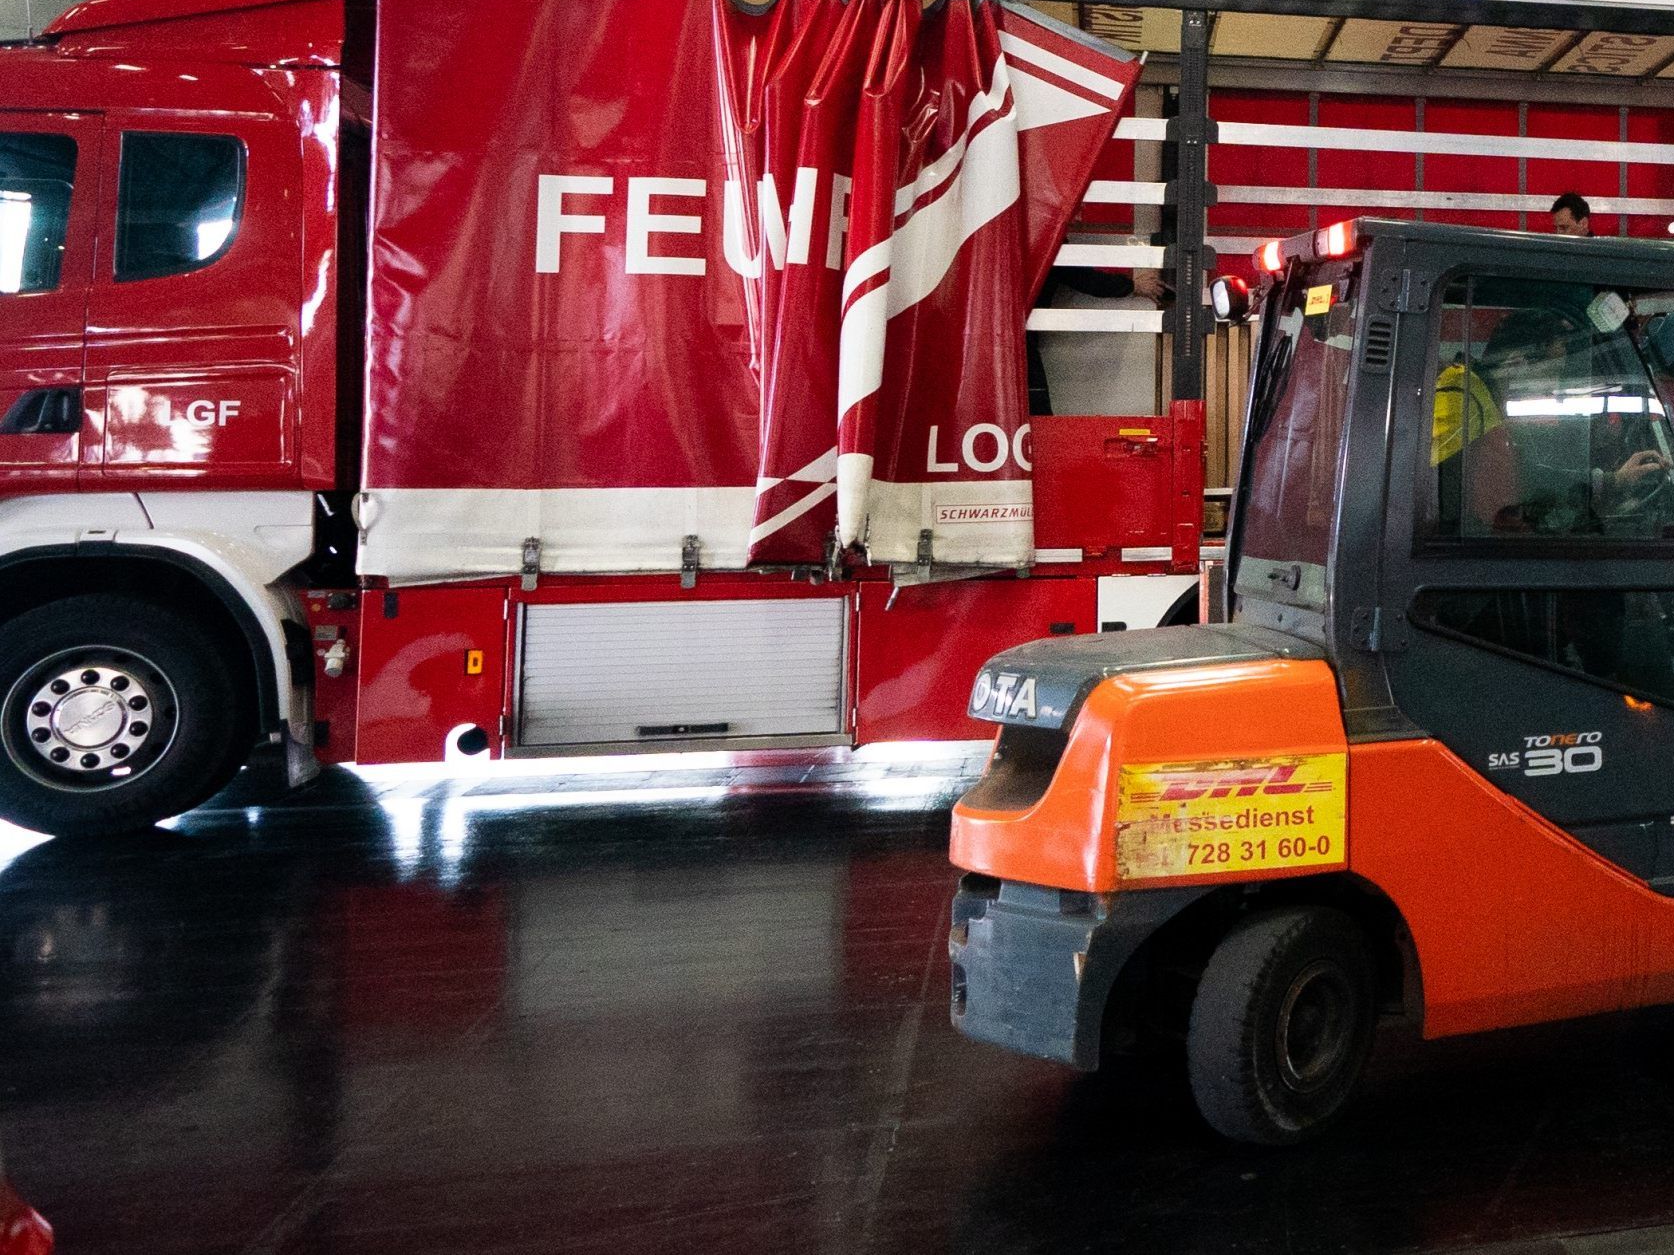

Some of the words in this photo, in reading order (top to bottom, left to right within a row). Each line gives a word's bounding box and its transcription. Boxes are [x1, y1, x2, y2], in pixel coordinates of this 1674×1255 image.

[940, 507, 1034, 520] SCHWARZMÜL
[1488, 751, 1520, 767] SAS
[1523, 745, 1603, 777] 30
[1158, 765, 1307, 801] DHL
[1187, 841, 1231, 866] 728
[1240, 839, 1267, 862] 31
[1278, 835, 1331, 859] 60-0
